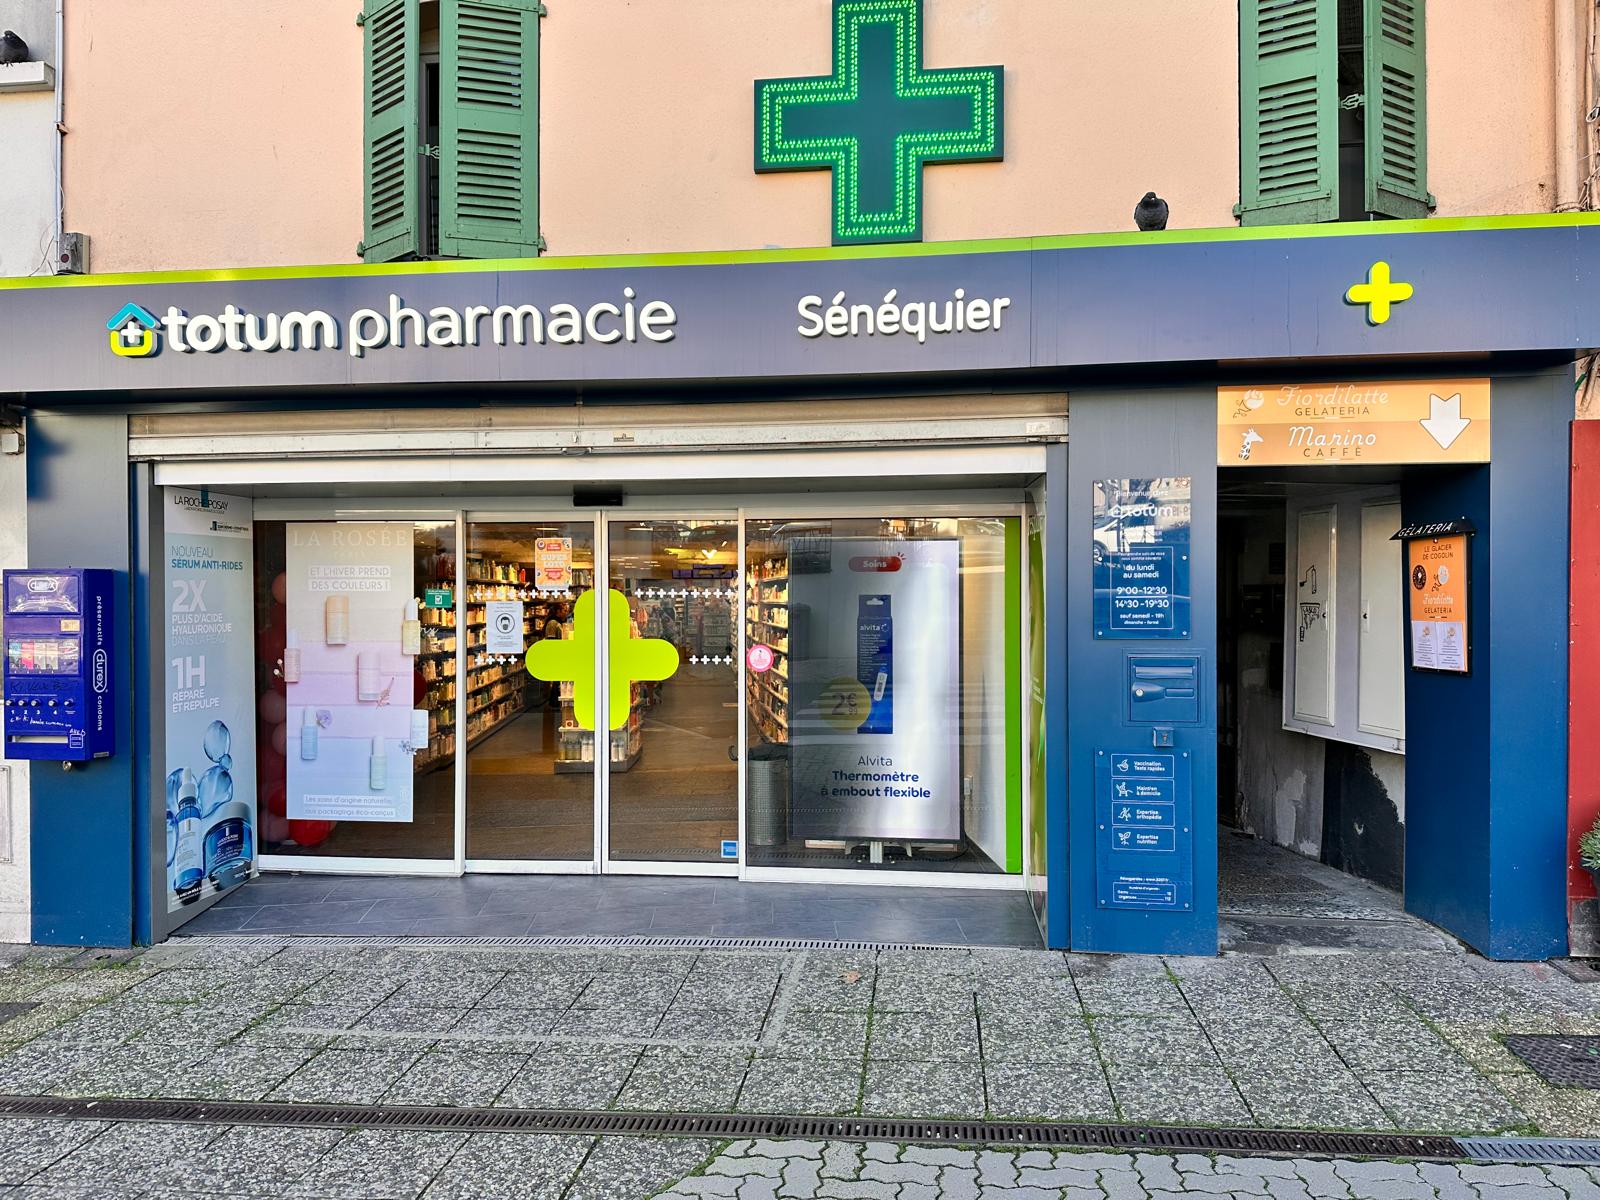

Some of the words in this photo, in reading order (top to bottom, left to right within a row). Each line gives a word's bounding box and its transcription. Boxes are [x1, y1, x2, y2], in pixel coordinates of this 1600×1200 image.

[161, 304, 339, 352] totum
[348, 287, 678, 357] pharmacie
[797, 288, 1011, 344] Sénéquier
[1276, 384, 1390, 406] Fiordilatte
[1294, 406, 1371, 417] GELATERIA
[1288, 425, 1377, 447] Marino
[293, 529, 321, 546] LA
[331, 526, 408, 546] ROSÉE
[1397, 521, 1454, 538] GELATERIA
[171, 545, 214, 559] NOUVEAU
[1431, 543, 1452, 552] GLACIER
[1430, 552, 1454, 560] COGOLIN
[171, 557, 201, 569] SÉRUM
[201, 560, 243, 571] ANTI-RIDES
[863, 559, 888, 568] Soins
[310, 566, 321, 576] ET
[323, 566, 356, 576] L'HIVER
[358, 566, 389, 576] PREND
[311, 581, 330, 590] DES
[332, 581, 383, 590] COULEURS
[172, 579, 207, 613] 2X
[172, 614, 194, 625] PLUS
[194, 613, 223, 623] D'ACIDE
[172, 623, 232, 636] HYALURONIQUE
[96, 654, 104, 688] durex
[171, 655, 206, 690] 1H
[172, 702, 183, 713] ET
[183, 697, 220, 711] REPULPE
[857, 755, 893, 767] Alvita
[831, 770, 920, 782] Thermomètre
[820, 785, 828, 796] à
[831, 785, 881, 797] embout
[883, 786, 931, 798] flexible
